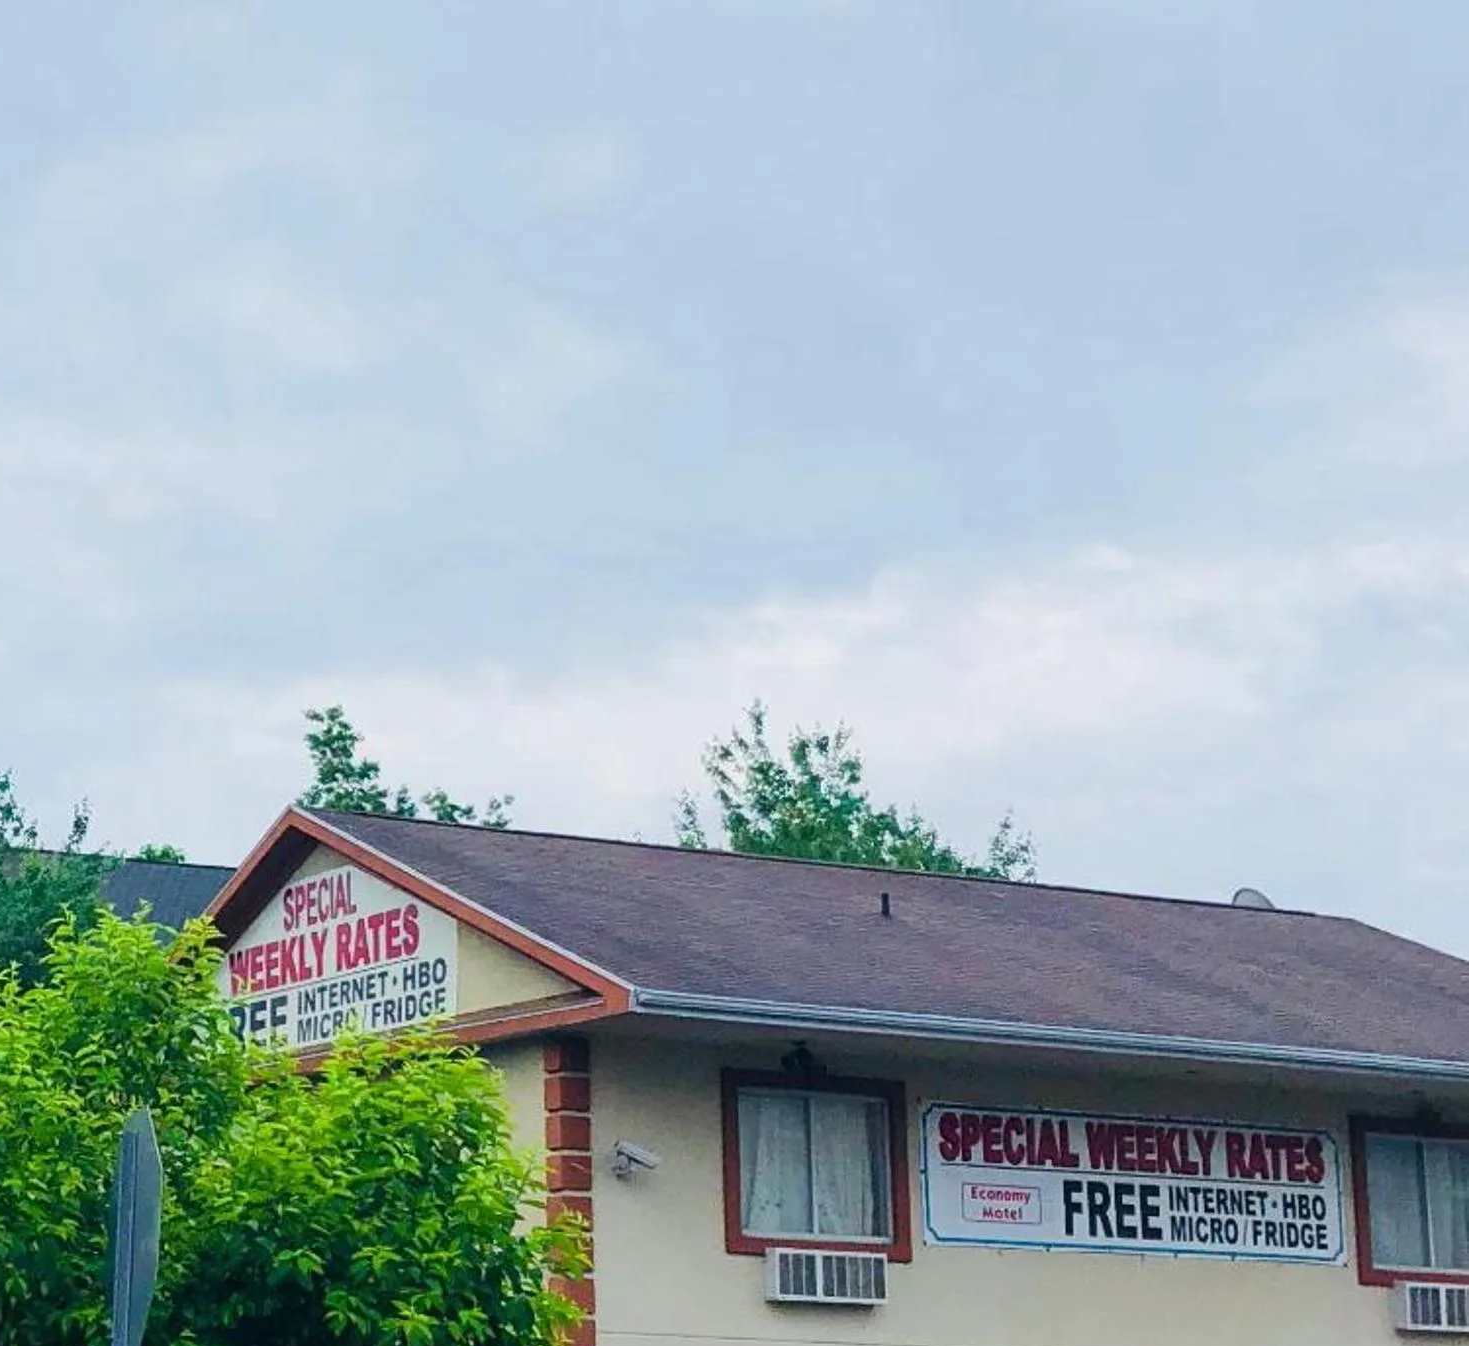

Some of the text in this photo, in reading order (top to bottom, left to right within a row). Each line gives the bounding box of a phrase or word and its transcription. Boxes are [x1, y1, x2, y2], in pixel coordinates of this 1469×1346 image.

[284, 871, 357, 932] SPECIAL
[230, 904, 420, 997] WEEKLY RATES
[297, 957, 447, 1016] INTERNET HBO
[938, 1111, 1326, 1185] SPECIAL WEEKLY RATES
[971, 1186, 1031, 1205] Economy
[983, 1206, 1023, 1221] Motel
[1062, 1179, 1163, 1240] FREE
[1168, 1185, 1327, 1221] INTERNET HBO
[1252, 1221, 1328, 1250] FRIDGE
